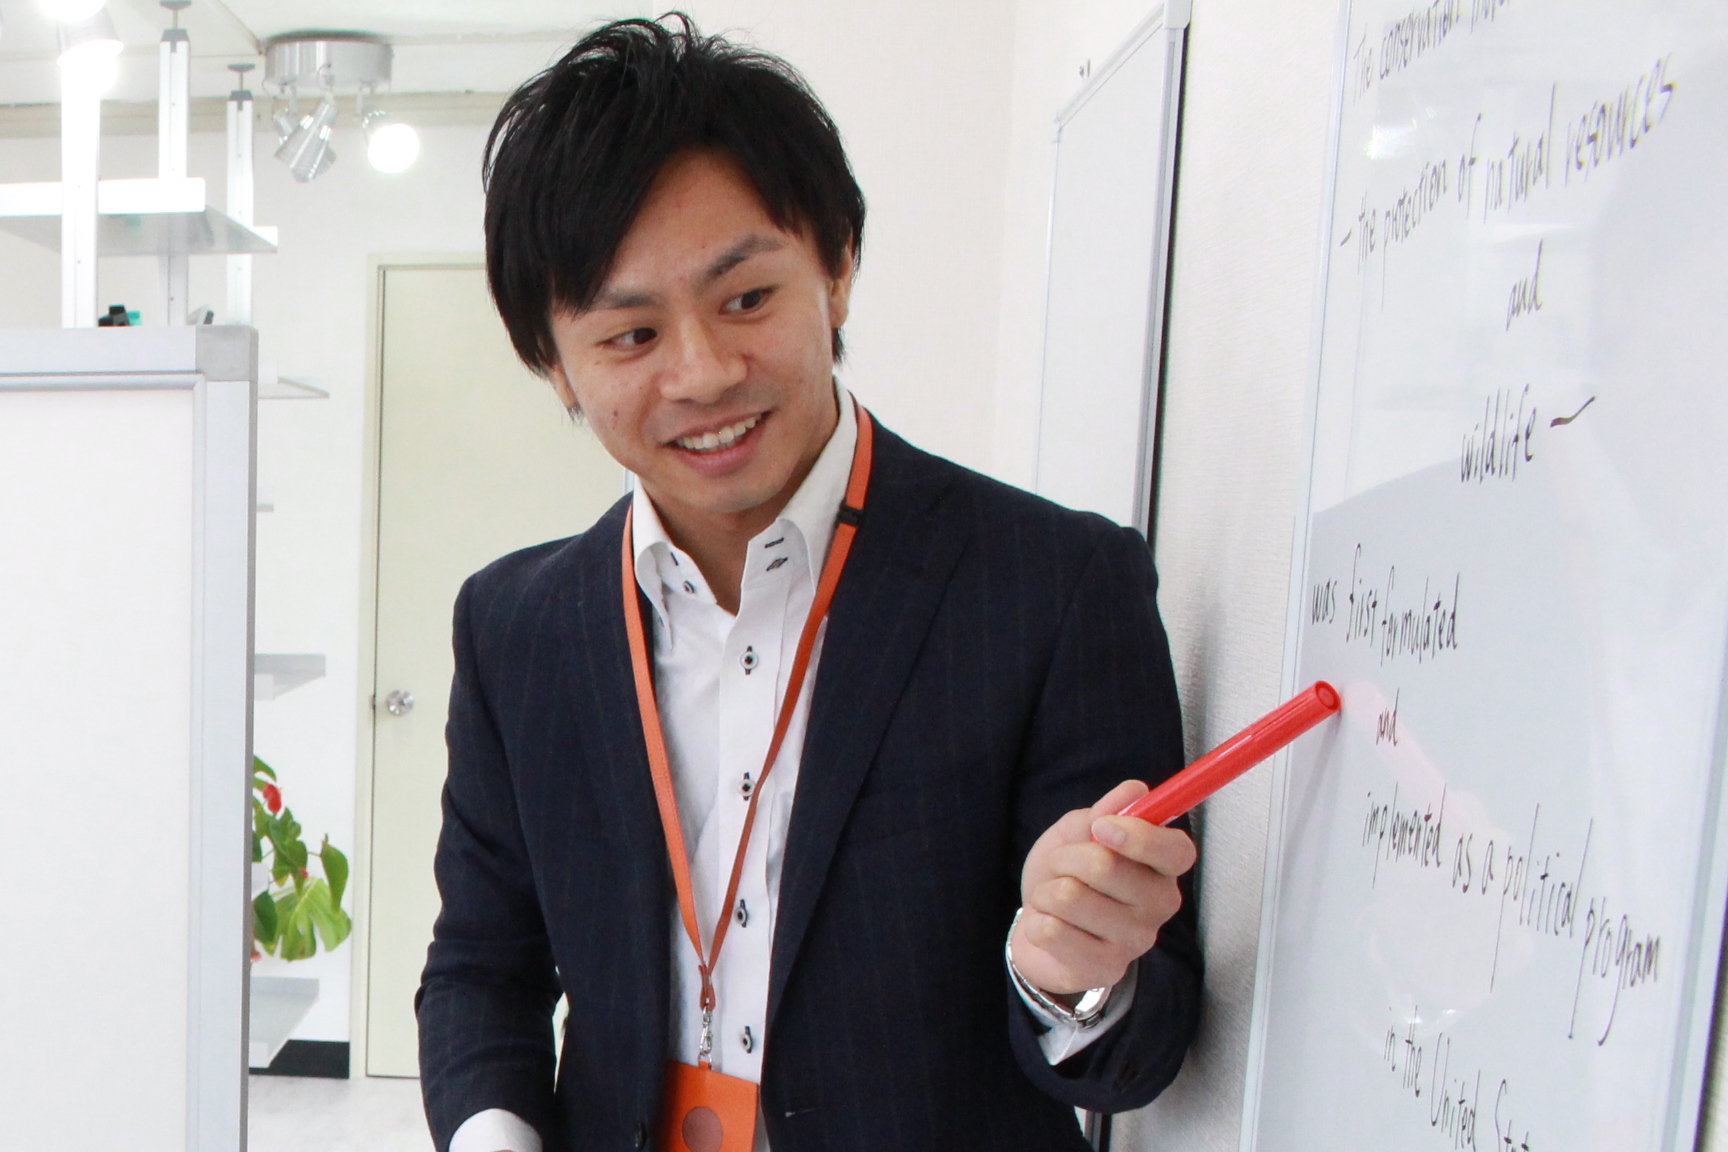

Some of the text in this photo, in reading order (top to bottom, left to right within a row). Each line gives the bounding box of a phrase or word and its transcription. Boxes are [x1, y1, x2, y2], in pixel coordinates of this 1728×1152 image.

[1357, 189, 1376, 275] the
[1381, 159, 1447, 312] protection
[1458, 112, 1482, 220] of
[1483, 82, 1557, 224] natural
[1564, 52, 1674, 188] resources
[1506, 239, 1543, 331] and
[1461, 383, 1537, 485] wildlife
[1312, 543, 1460, 668] was first formulated
[1376, 687, 1399, 747] and
[1362, 782, 1660, 1047] implemented as a political program
[1383, 1006, 1396, 1073] in
[1403, 1004, 1422, 1098] the
[1430, 1033, 1481, 1152] United
